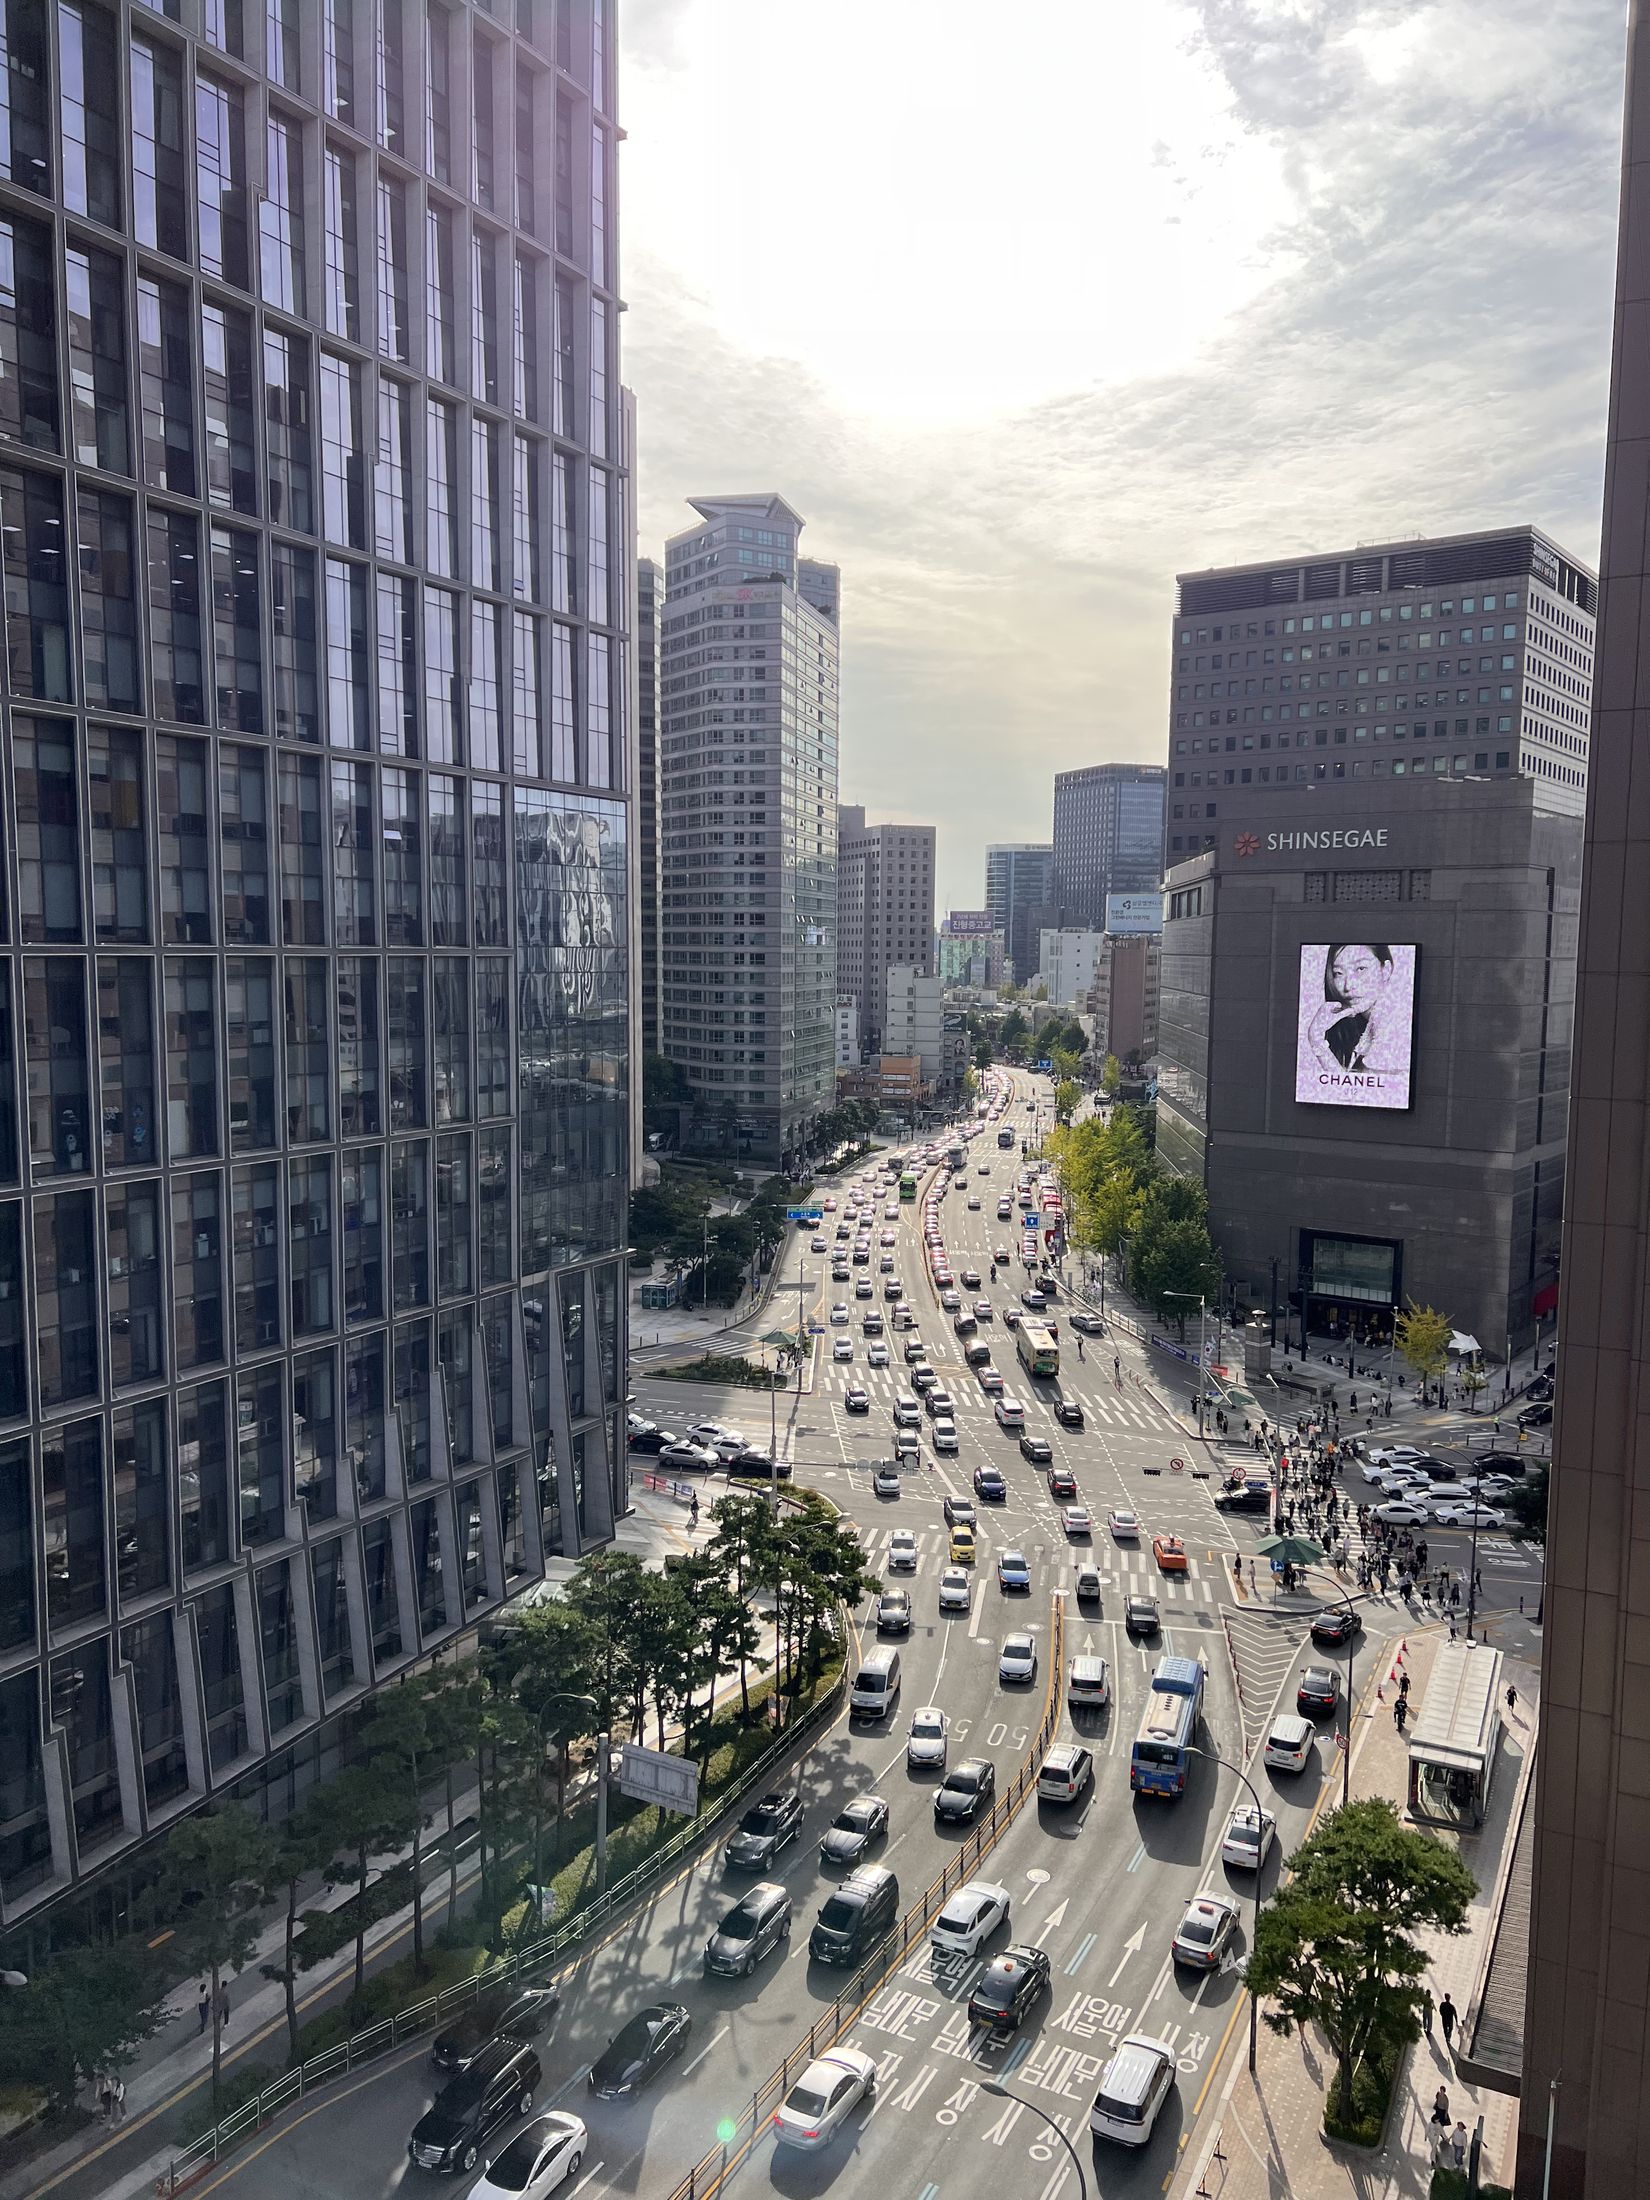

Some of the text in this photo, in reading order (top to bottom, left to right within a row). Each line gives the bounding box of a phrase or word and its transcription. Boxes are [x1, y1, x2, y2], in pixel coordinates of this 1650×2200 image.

[1267, 828, 1388, 851] SHINSEGAE
[1319, 1074, 1385, 1088] CHANEL
[986, 1722, 1030, 1750] 50
[858, 1986, 941, 2041] 남대문
[930, 2010, 1016, 2069] 남대문
[1051, 1990, 1133, 2046] 서울역
[1017, 2039, 1104, 2101] 남대문
